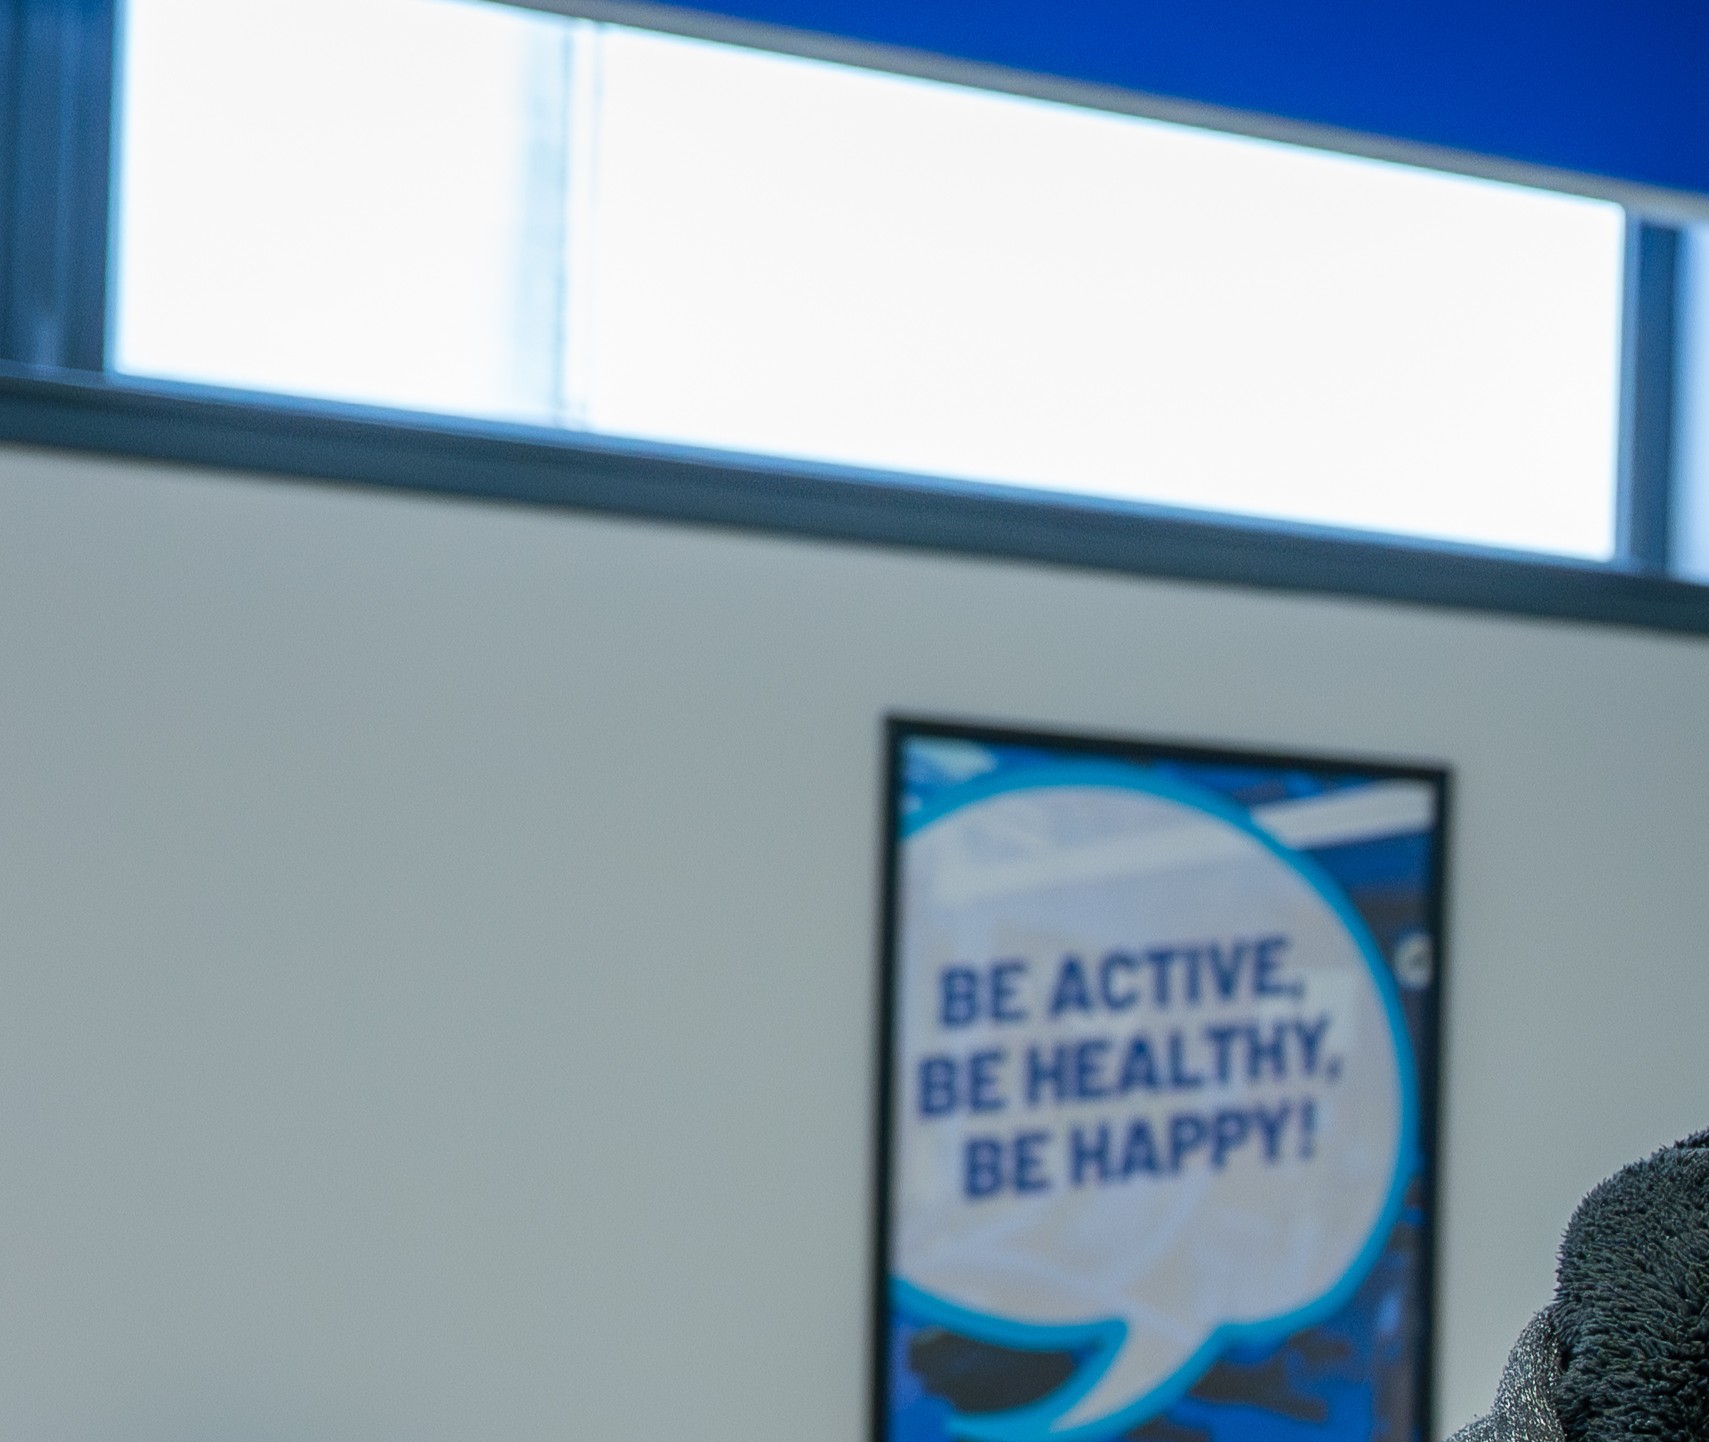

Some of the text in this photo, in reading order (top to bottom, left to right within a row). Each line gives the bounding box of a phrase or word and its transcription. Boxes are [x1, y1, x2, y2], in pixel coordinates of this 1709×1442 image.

[940, 935, 1305, 1030] BE ACTIVE,
[918, 1015, 1342, 1122] BE HEALTHY,
[963, 1097, 1318, 1201] BE HAPPY!
